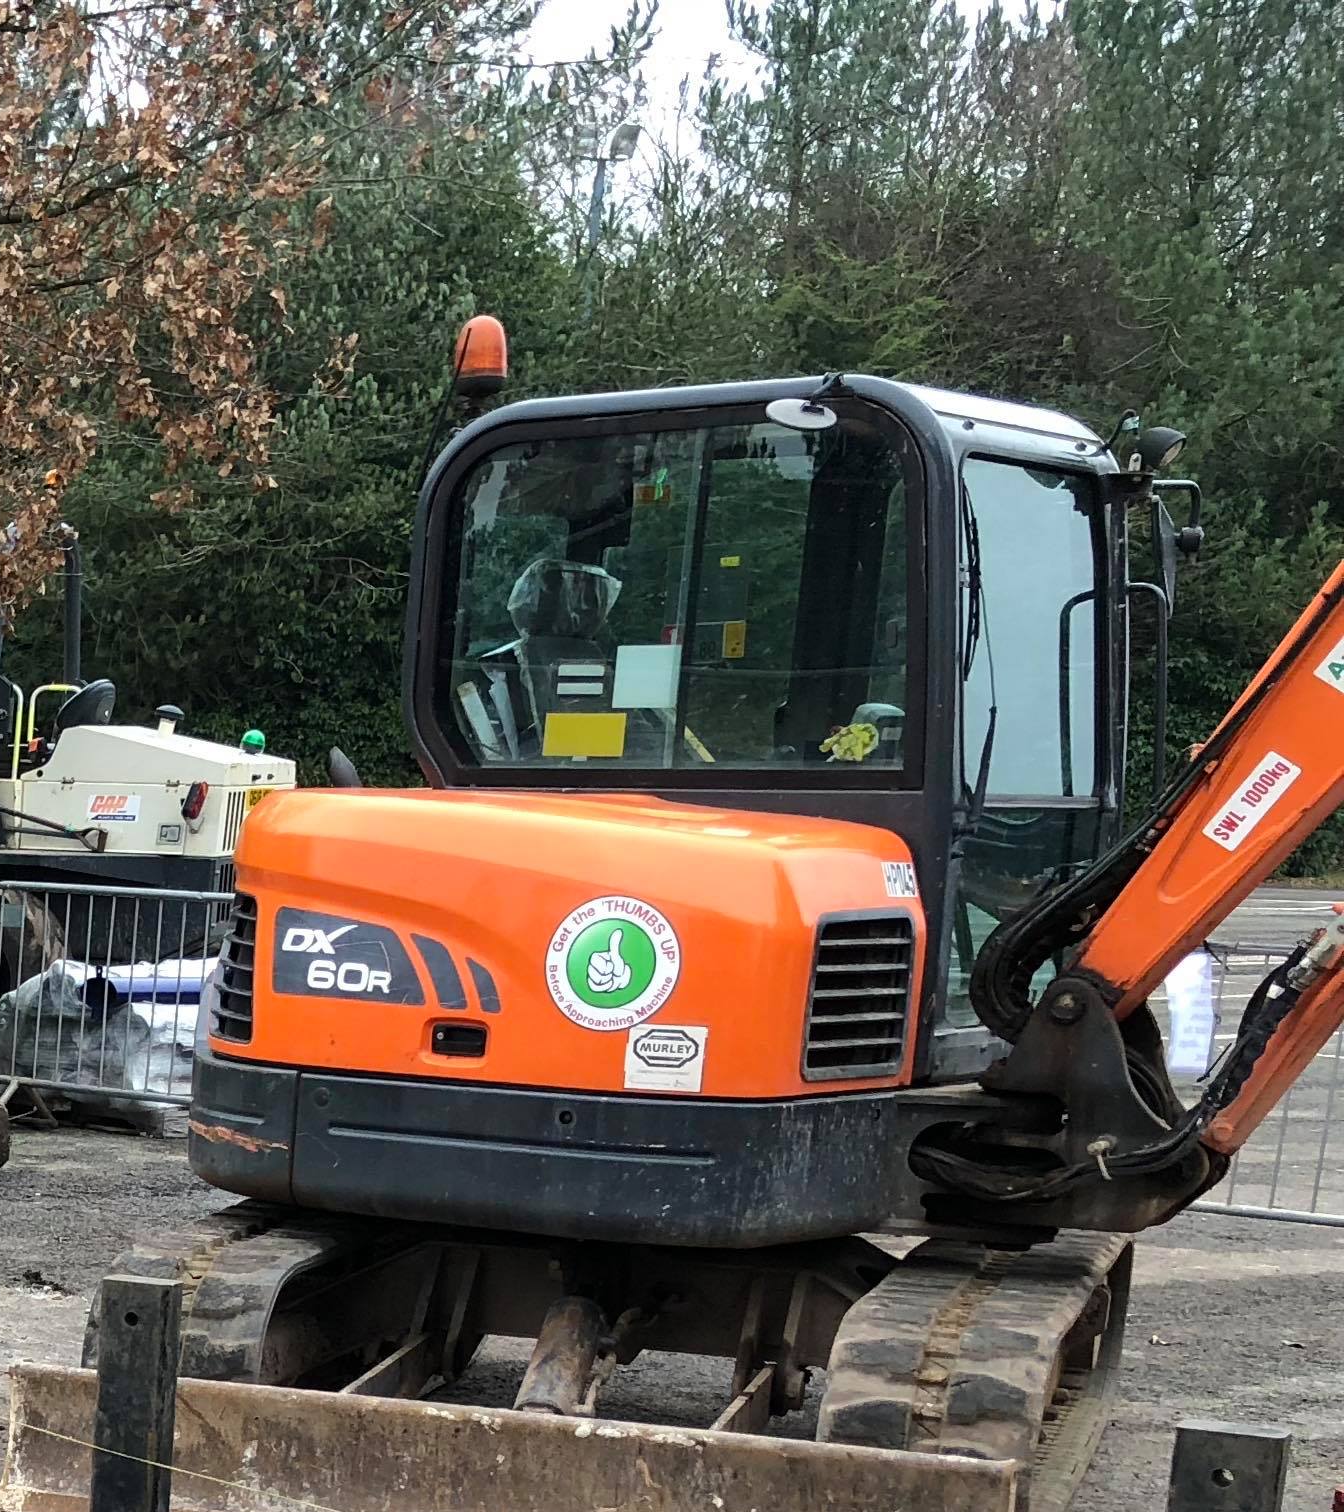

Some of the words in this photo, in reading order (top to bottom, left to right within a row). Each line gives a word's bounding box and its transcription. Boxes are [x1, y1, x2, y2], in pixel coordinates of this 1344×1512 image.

[1213, 811, 1247, 841] SWL
[1241, 761, 1291, 808] 1000kg
[282, 924, 359, 954] DX
[552, 927, 572, 953] Get
[572, 907, 596, 925] the
[307, 959, 392, 994] 60R
[548, 964, 565, 1003] Before
[563, 1003, 635, 1028] Approaching
[635, 976, 673, 1019] Machine
[640, 1042, 692, 1054] MURLEY
